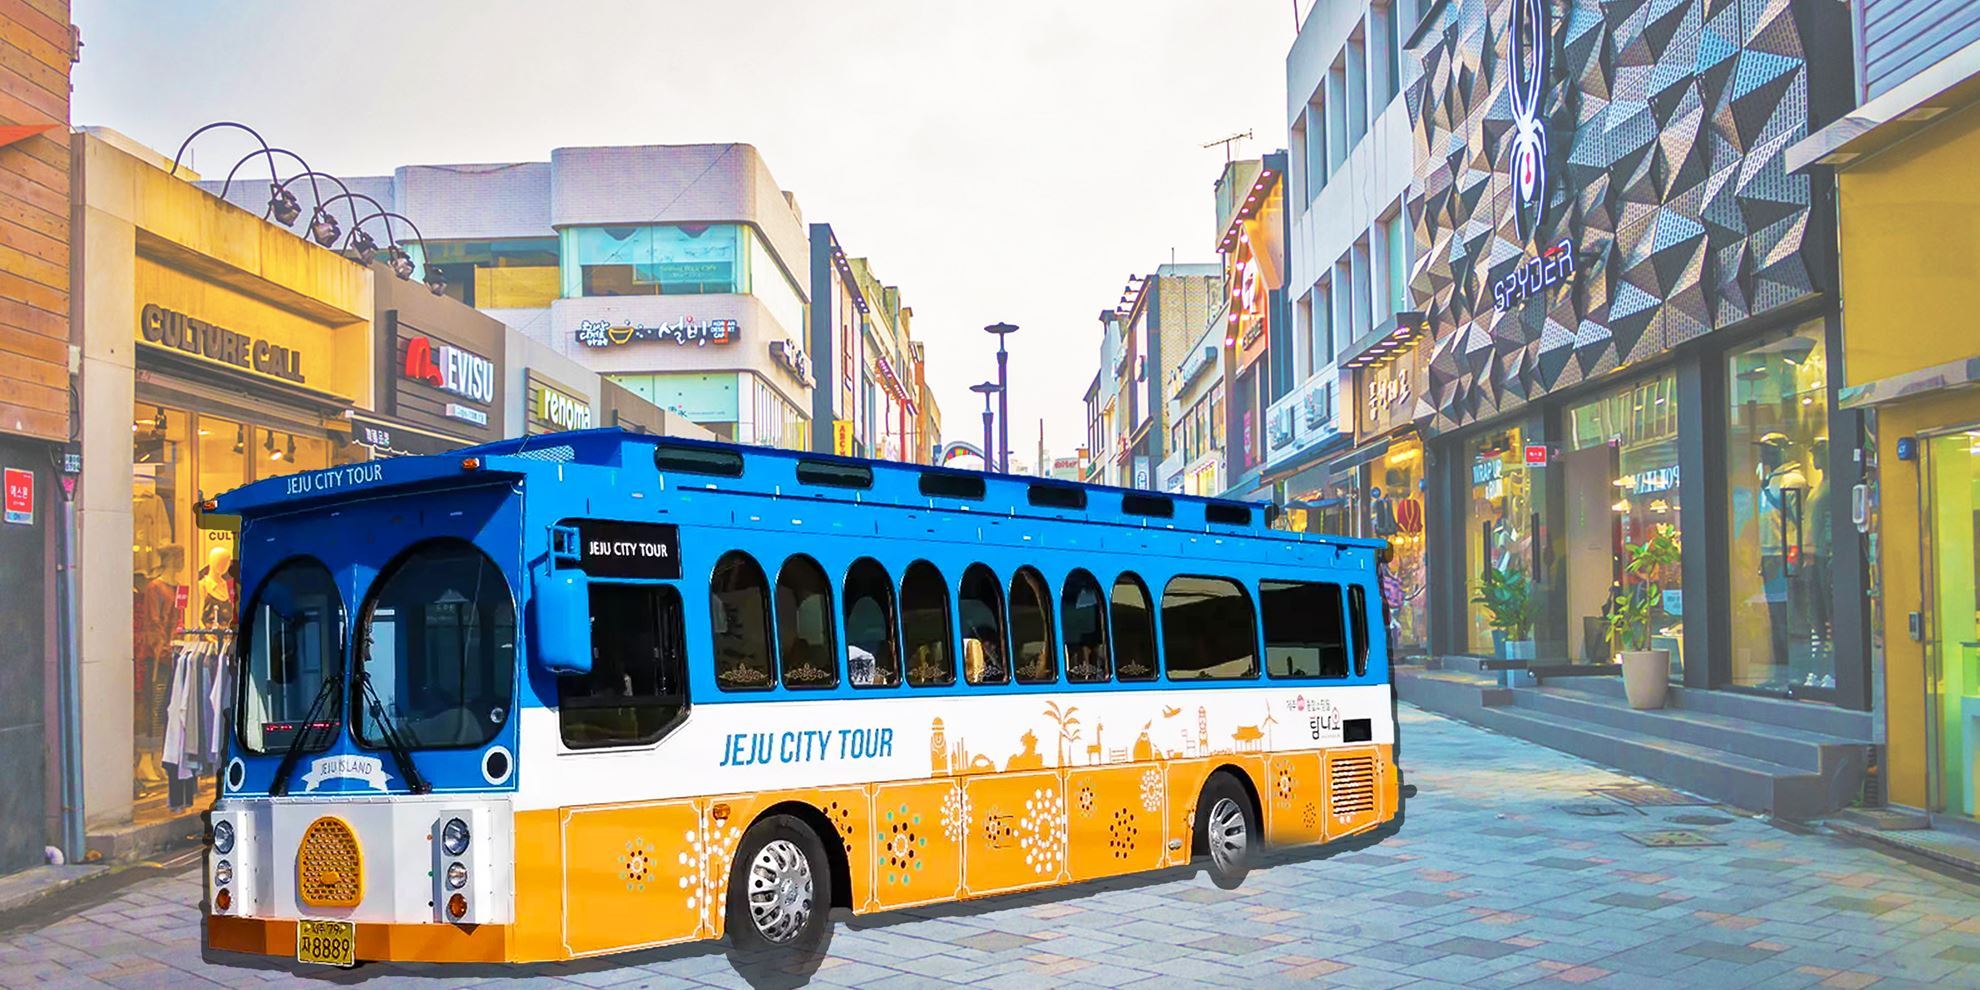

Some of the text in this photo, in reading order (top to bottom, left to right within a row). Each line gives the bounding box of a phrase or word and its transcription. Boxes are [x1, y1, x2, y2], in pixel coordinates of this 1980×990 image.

[1494, 239, 1573, 313] SPYDER
[141, 303, 305, 383] CULTURE CALL
[658, 315, 706, 346] 설빙
[448, 347, 494, 402] EVISU
[545, 389, 591, 430] renoma
[286, 464, 383, 495] JEJU CITY TOUR
[590, 541, 668, 557] JEJU CITY TOUR
[719, 727, 893, 767] JEJU CITY TOUR
[320, 760, 373, 776] JEJU ISLAND
